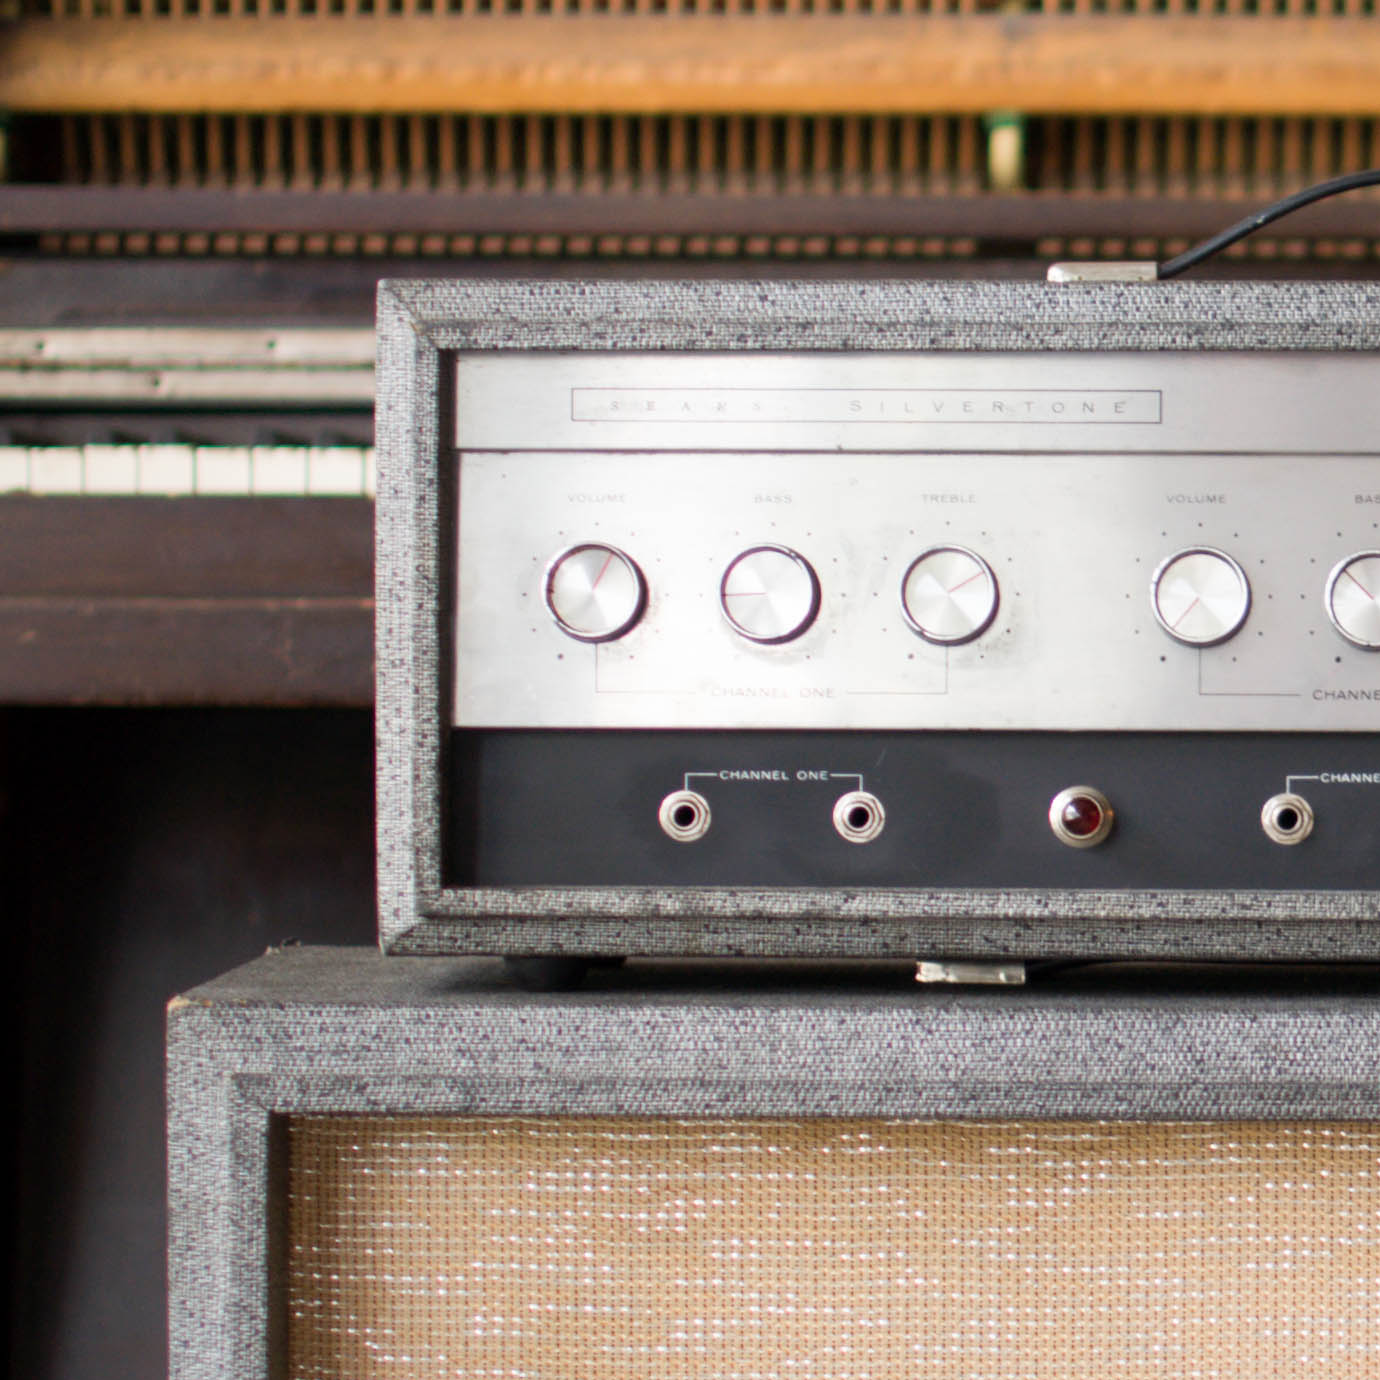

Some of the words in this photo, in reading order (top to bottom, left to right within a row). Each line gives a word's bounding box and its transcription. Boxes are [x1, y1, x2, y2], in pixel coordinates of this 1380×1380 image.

[848, 400, 1129, 414] SILVERTONE
[921, 493, 977, 504] TREBLE
[1166, 493, 1227, 504] VOLUME
[718, 769, 789, 781] CHANNEL
[796, 769, 829, 781] ONE
